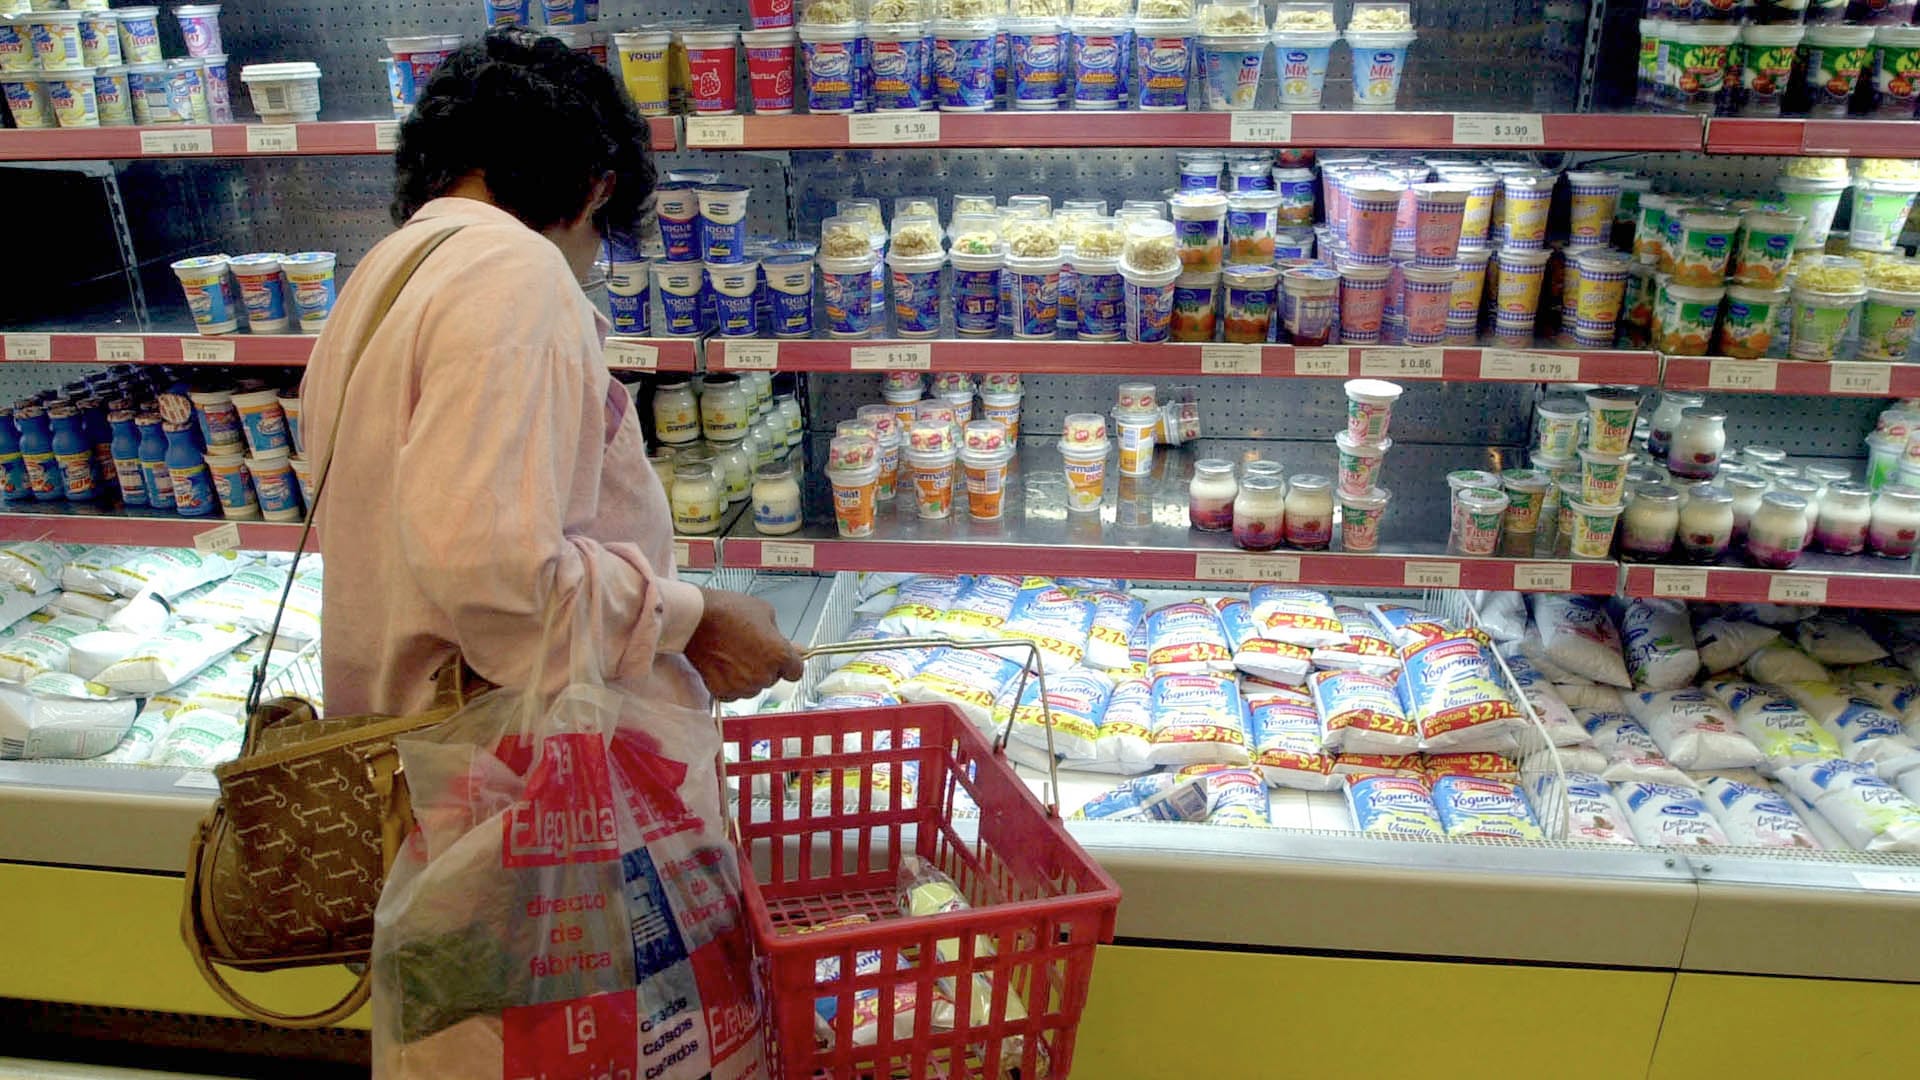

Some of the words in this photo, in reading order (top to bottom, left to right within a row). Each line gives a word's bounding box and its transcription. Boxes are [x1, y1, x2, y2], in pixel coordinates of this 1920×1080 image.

[628, 50, 663, 62] yogur
[1285, 63, 1310, 77] Mix
[1369, 63, 1395, 77] Mix
[702, 130, 708, 138] $
[894, 124, 900, 134] $
[904, 122, 926, 134] 1.39
[1249, 128, 1254, 136] $
[1258, 127, 1276, 136] 1.37
[1494, 125, 1501, 137] $
[1504, 125, 1528, 138] 3.99
[739, 354, 744, 363] $
[888, 353, 894, 362] $
[898, 353, 918, 362] 1.39
[1401, 358, 1406, 368] $
[1409, 358, 1432, 368] 0.86
[1530, 363, 1536, 373] $
[1539, 363, 1562, 374] 0.79
[1191, 726, 1243, 744] $2,19
[511, 796, 618, 858] Elegida
[527, 893, 606, 917] directo
[550, 920, 583, 944] de
[565, 1004, 597, 1055] La
